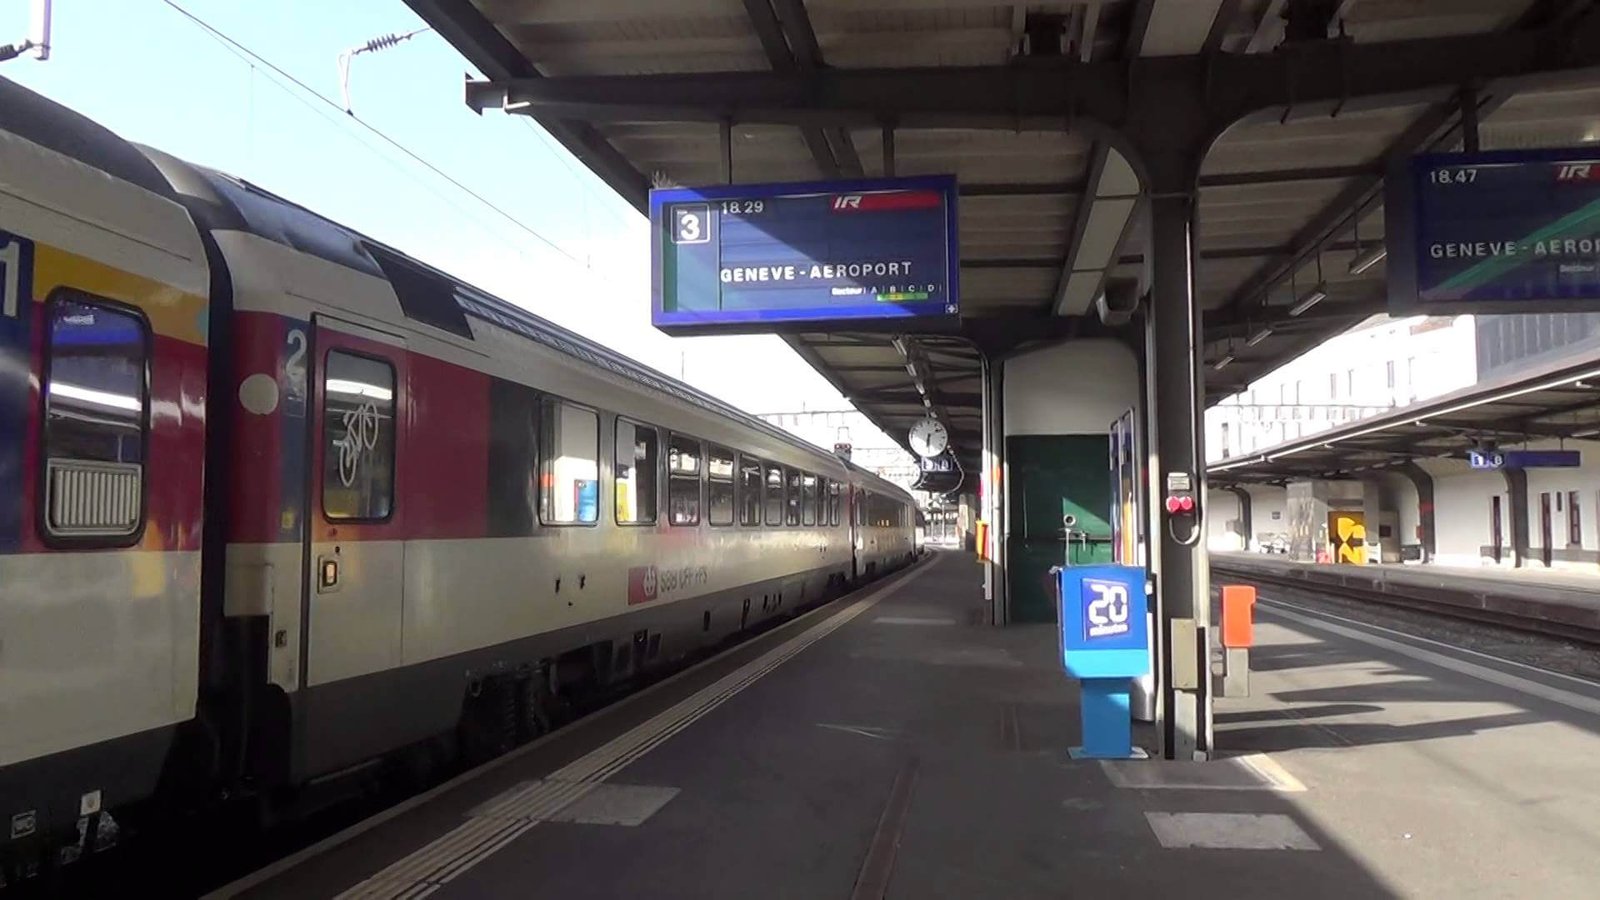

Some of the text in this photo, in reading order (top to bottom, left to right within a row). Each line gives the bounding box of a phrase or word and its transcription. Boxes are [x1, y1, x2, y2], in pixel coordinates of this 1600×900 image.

[1430, 169, 1477, 184] 18.47
[1559, 164, 1592, 179] IR
[834, 196, 862, 209] IR
[681, 214, 700, 240] 3
[0, 241, 20, 318] 1
[286, 329, 307, 375] 2
[1088, 584, 1128, 624] 20
